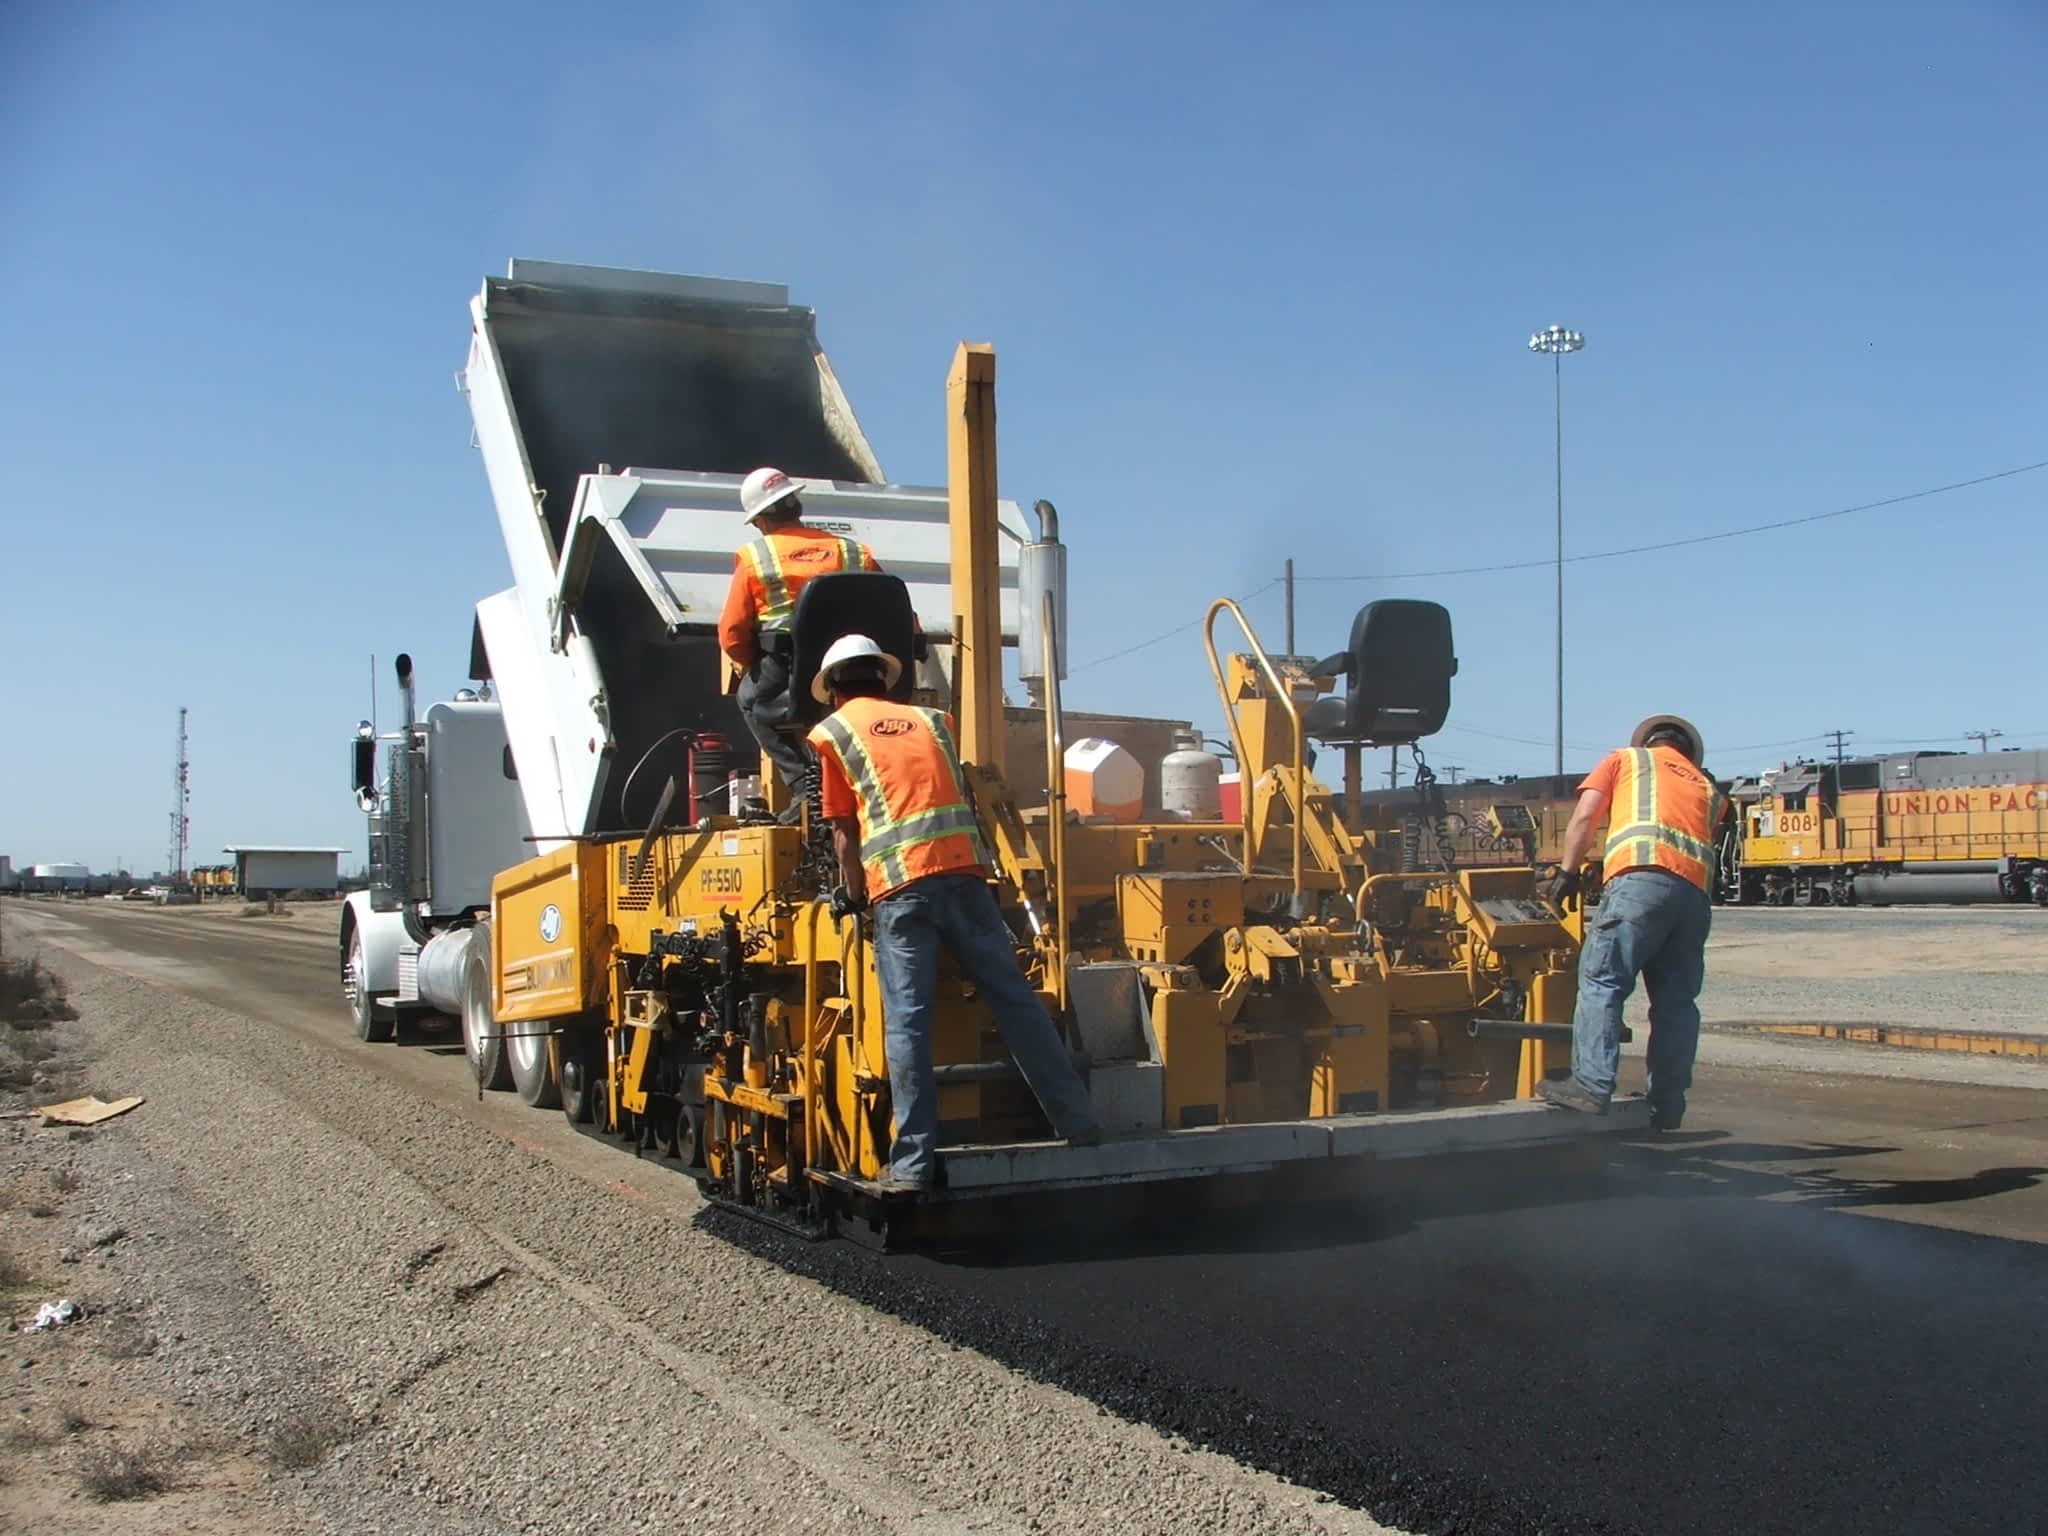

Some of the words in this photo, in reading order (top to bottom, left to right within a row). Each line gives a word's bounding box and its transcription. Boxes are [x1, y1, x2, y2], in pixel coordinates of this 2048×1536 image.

[1887, 793, 1969, 815] UNION
[1780, 814, 1812, 833] 808
[701, 867, 742, 893] PF-5510
